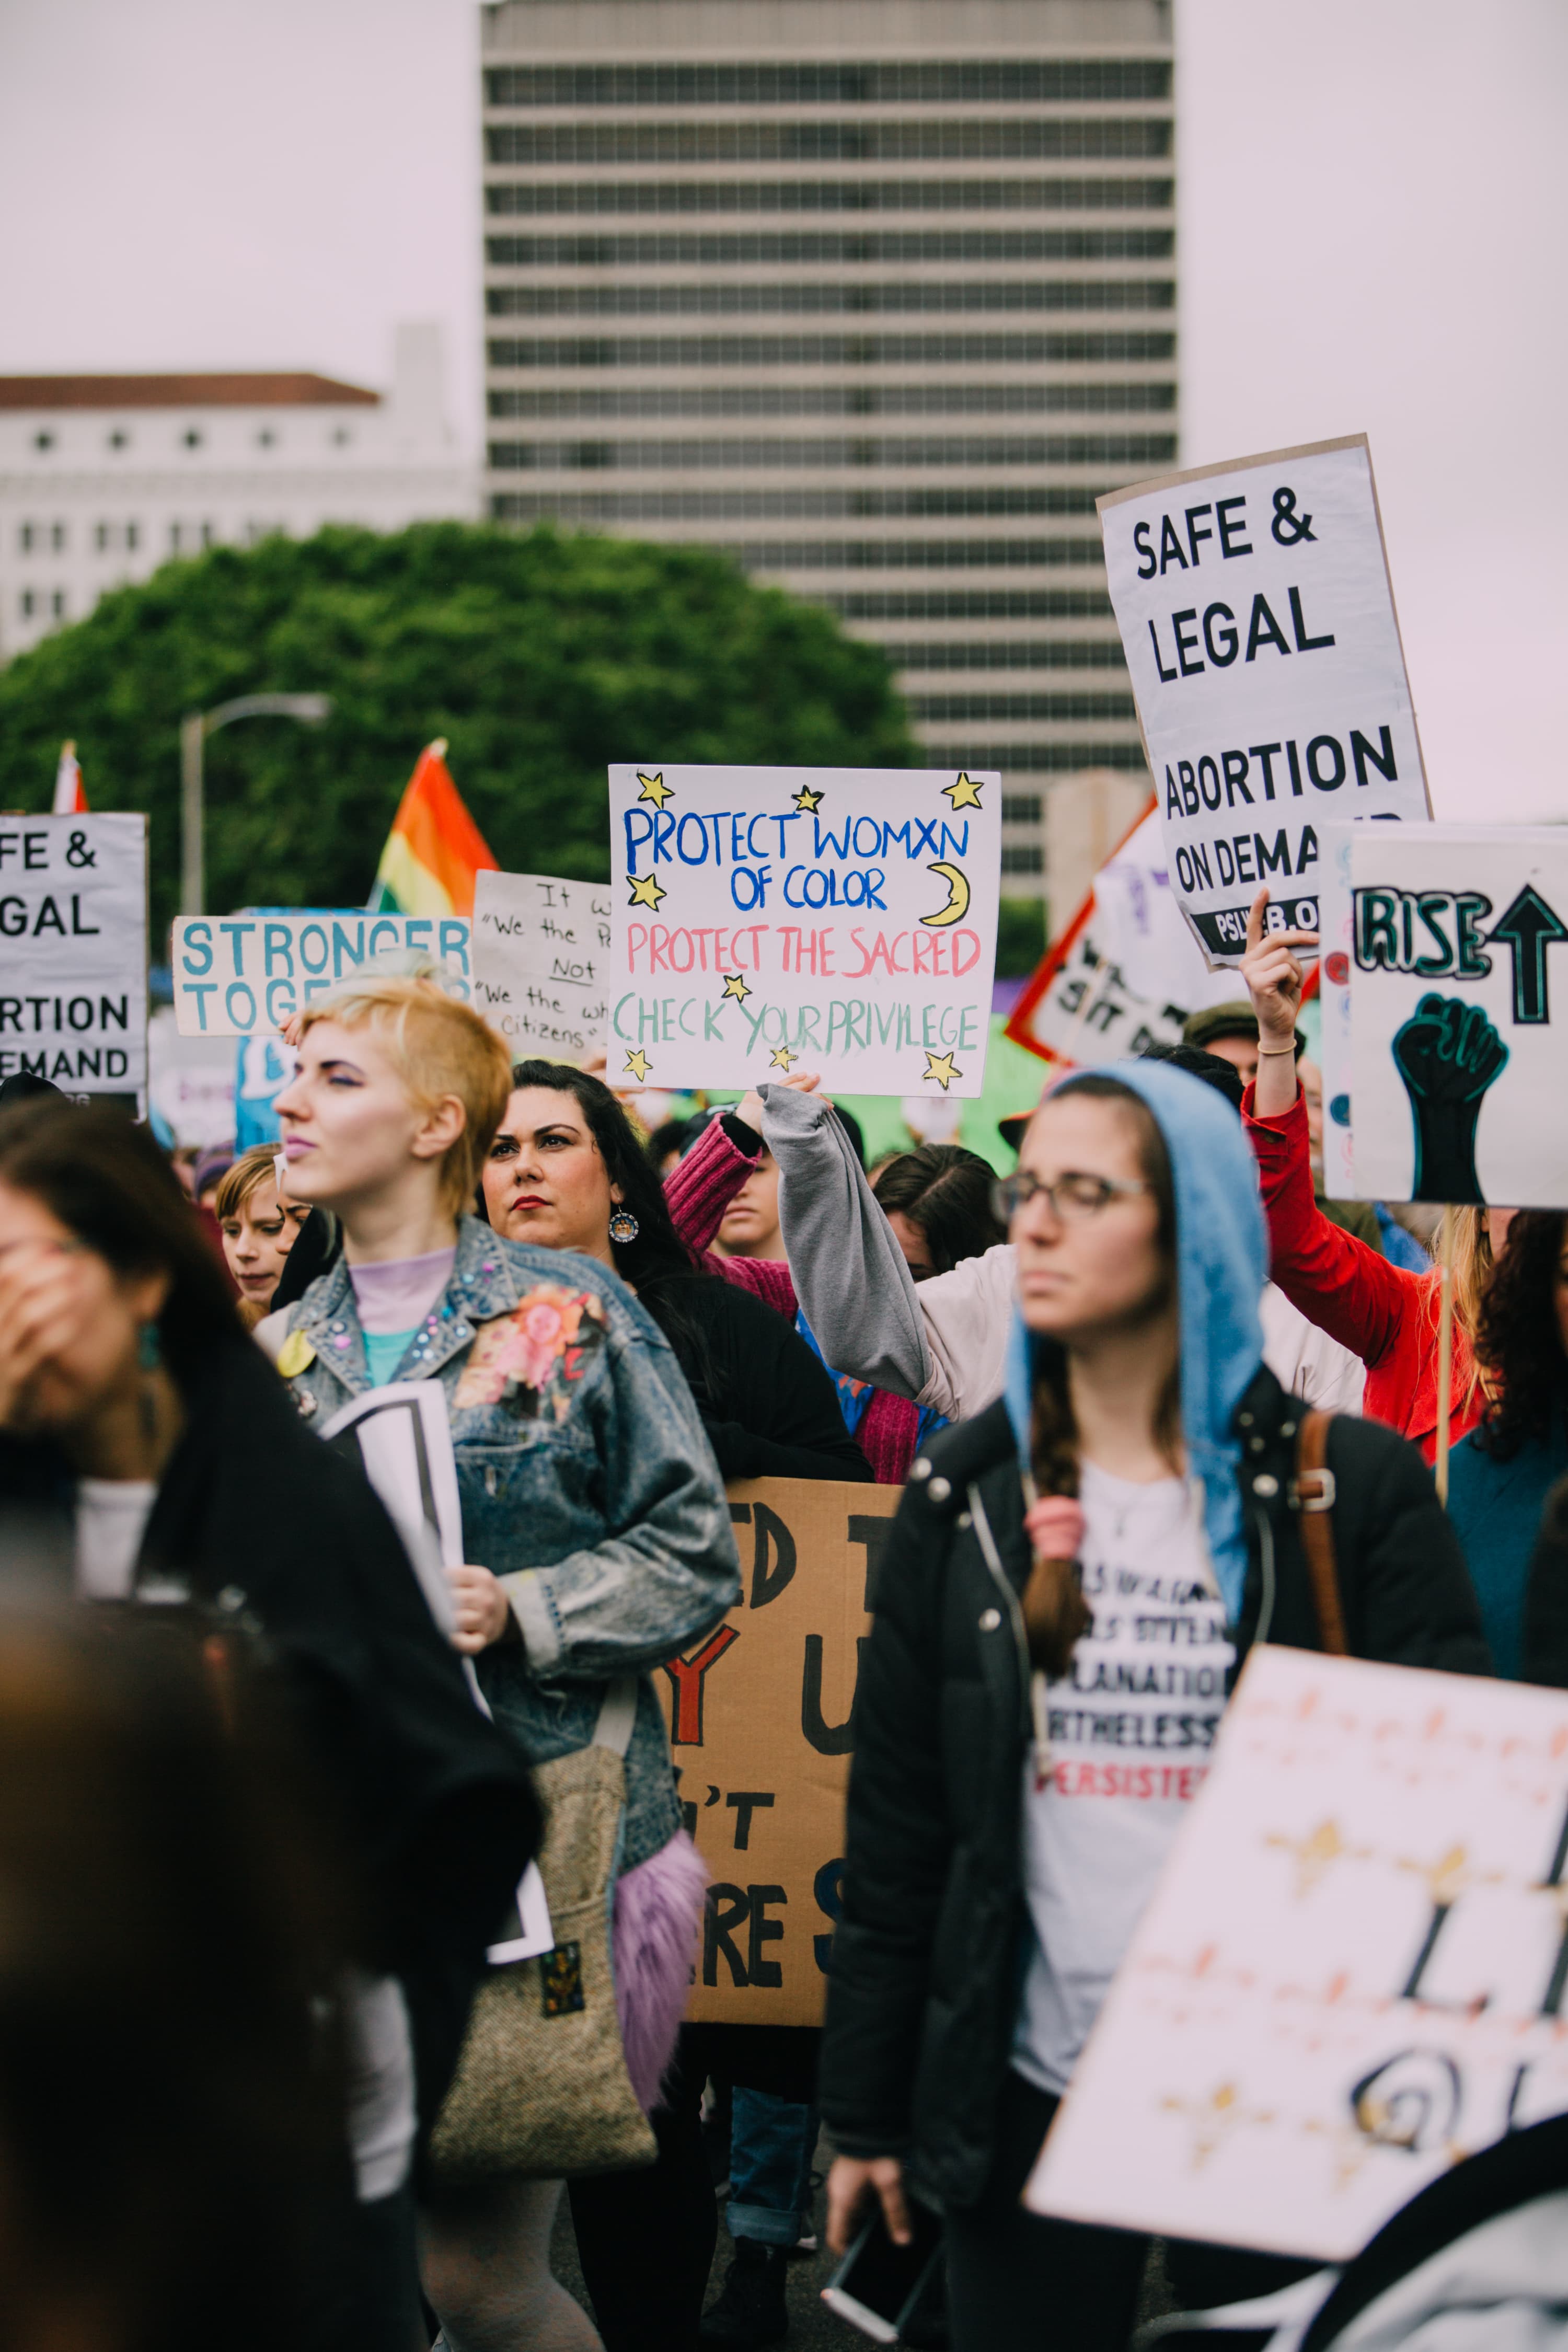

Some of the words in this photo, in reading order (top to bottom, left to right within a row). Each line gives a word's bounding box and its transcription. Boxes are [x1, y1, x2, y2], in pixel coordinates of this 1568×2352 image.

[1133, 495, 1253, 580] SAFE
[1271, 487, 1319, 547] &
[1147, 586, 1336, 684] LEGAL
[1165, 725, 1399, 821] ABORTION
[66, 831, 98, 868] &
[624, 808, 801, 874] PROTECT
[814, 815, 969, 860] WOMXN
[1176, 843, 1214, 893] ON
[537, 883, 570, 907] It
[731, 864, 772, 911] OF
[784, 865, 887, 910] COLOR
[0, 894, 100, 937] GAL
[540, 918, 577, 944] the
[1353, 887, 1492, 979] RISE
[182, 920, 469, 978] STRONGER
[552, 957, 596, 979] Not
[627, 923, 769, 974] PROTECT
[776, 926, 836, 977] THE
[841, 927, 981, 978] SACRED
[527, 985, 565, 1013] the
[613, 992, 726, 1044] CHECK
[738, 1002, 822, 1057] YOUR
[826, 1000, 978, 1057] PRIVILEGE
[689, 1882, 788, 1988] RE
